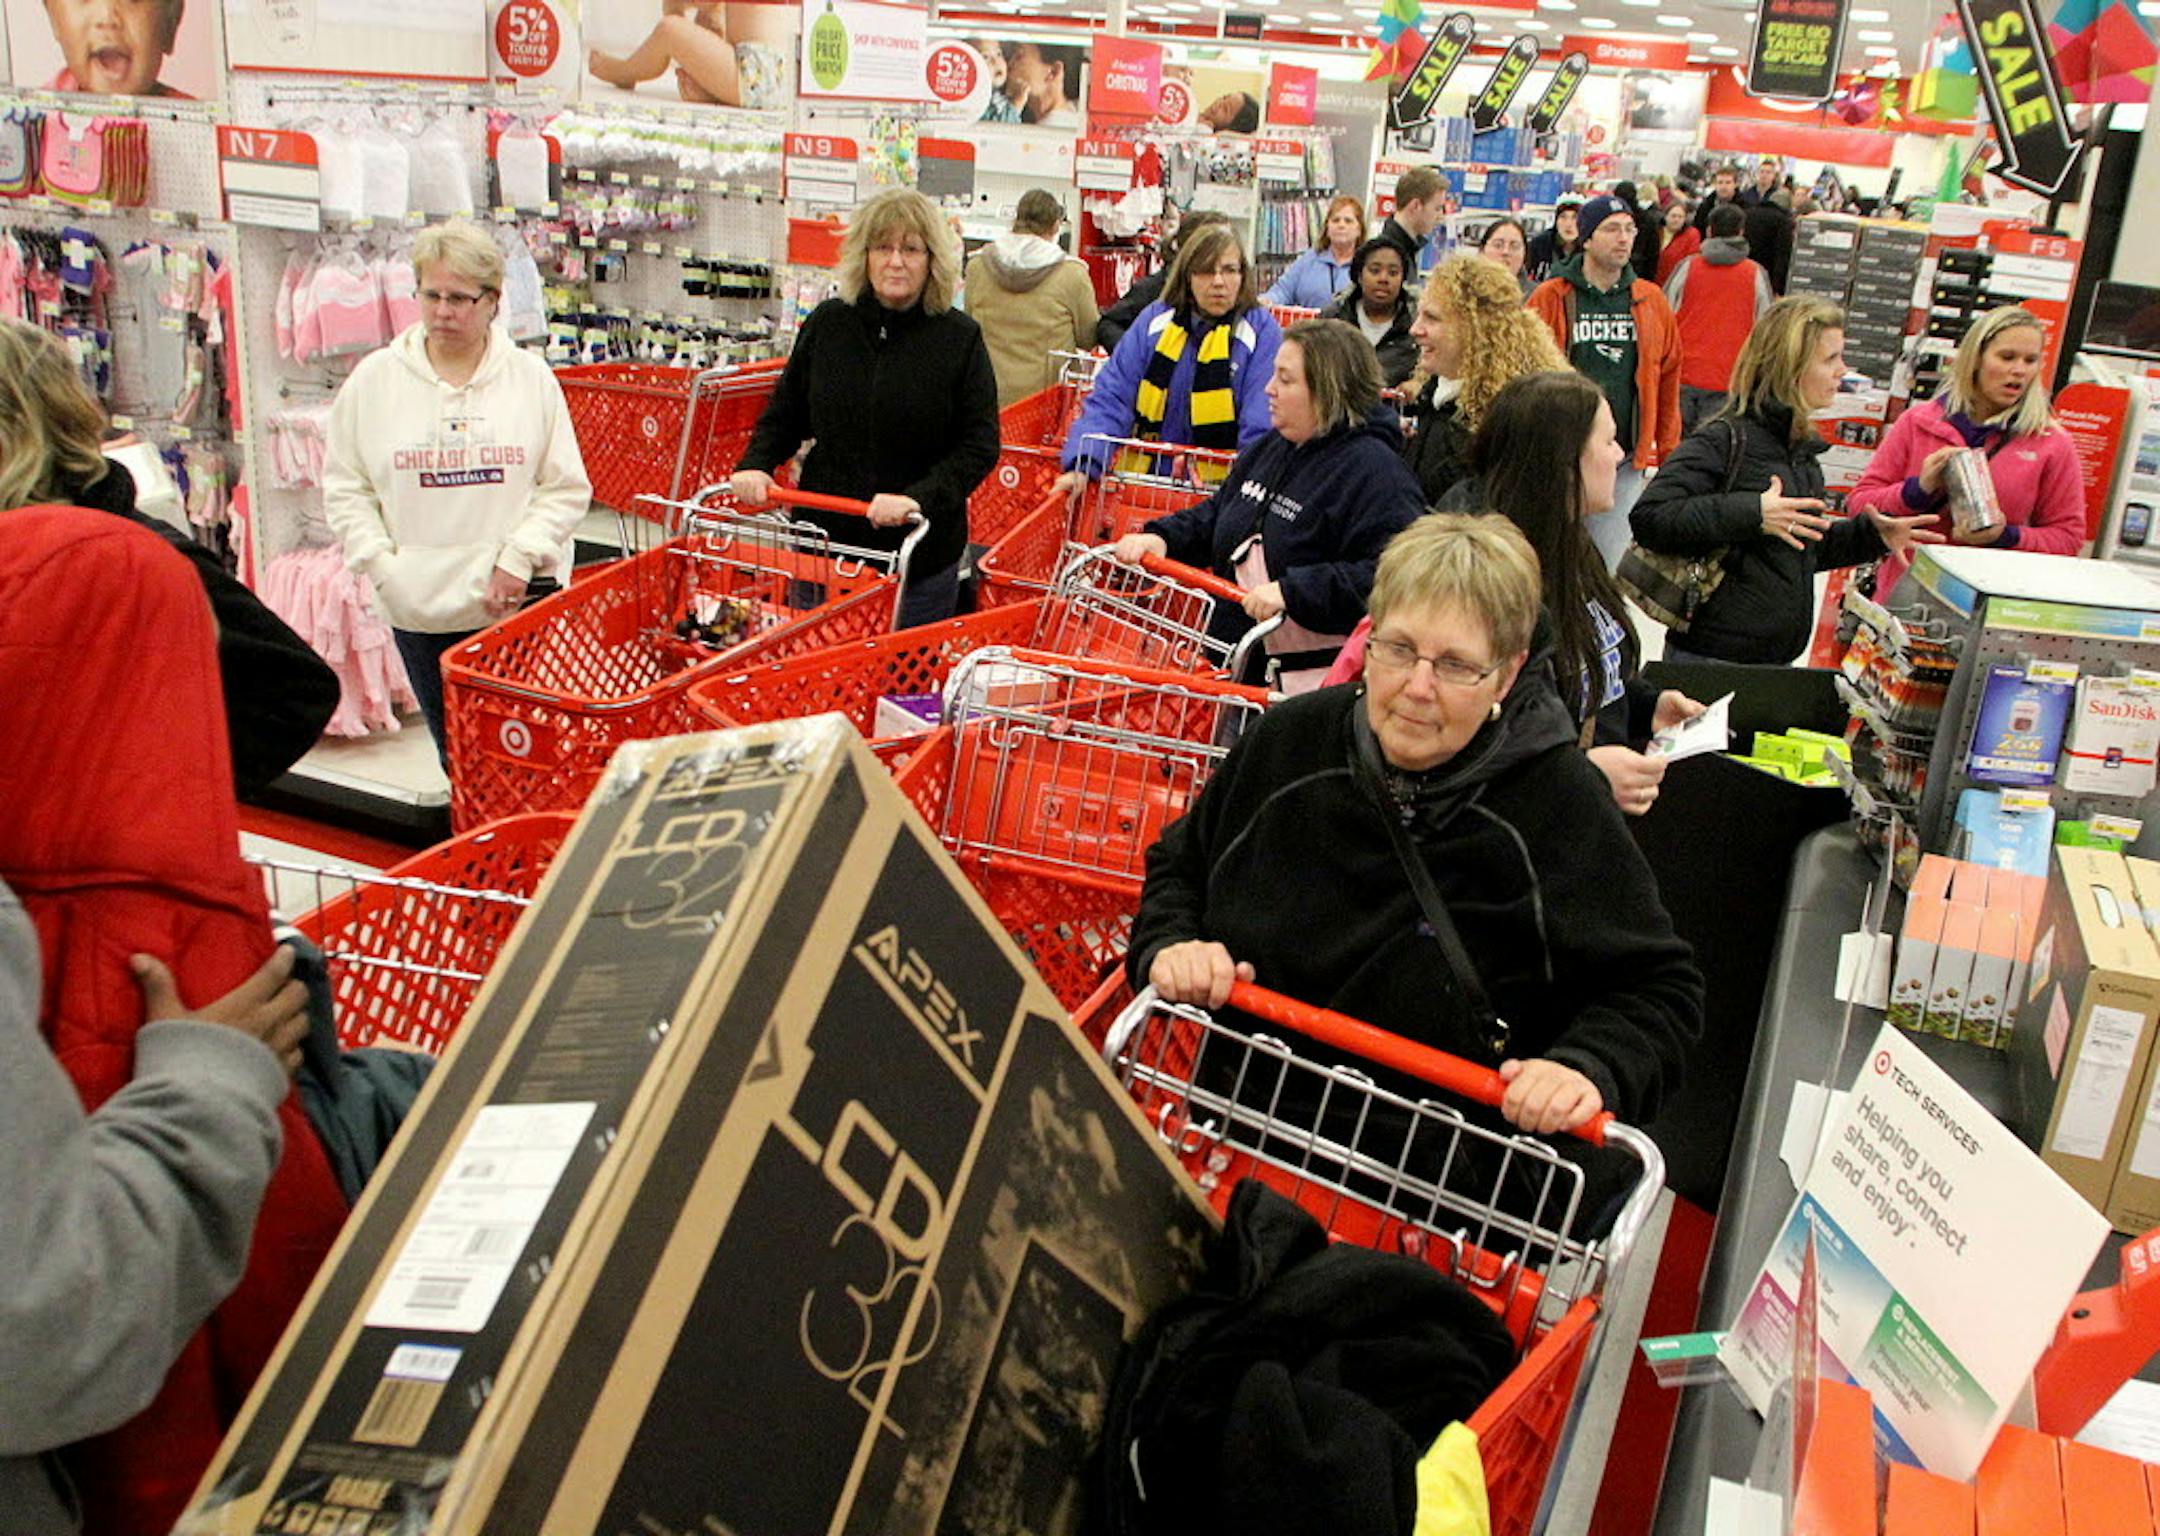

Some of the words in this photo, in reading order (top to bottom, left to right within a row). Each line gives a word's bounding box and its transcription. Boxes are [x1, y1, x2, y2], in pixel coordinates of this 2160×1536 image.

[508, 6, 548, 42] 5%
[816, 42, 840, 59] PRICE
[1596, 43, 1648, 60] Shoes
[1767, 37, 1829, 53] TARGET
[1411, 35, 1460, 99] SALE
[1485, 54, 1528, 109] SALE
[1981, 8, 2054, 137] SALE
[1541, 69, 1578, 117] SALE
[480, 446, 525, 465] CUBS
[437, 472, 488, 485] BASEBALL
[2089, 700, 2157, 720] SanDisk
[660, 755, 790, 793] APEX
[622, 840, 749, 932] 32
[865, 923, 984, 1067] APEX
[1890, 1066, 1922, 1102] TECH
[1857, 1096, 1920, 1170] Helping
[1917, 1159, 1954, 1201] you
[1830, 1149, 1865, 1187] and
[1844, 1124, 1891, 1186] share,
[1896, 1178, 1969, 1256] connect
